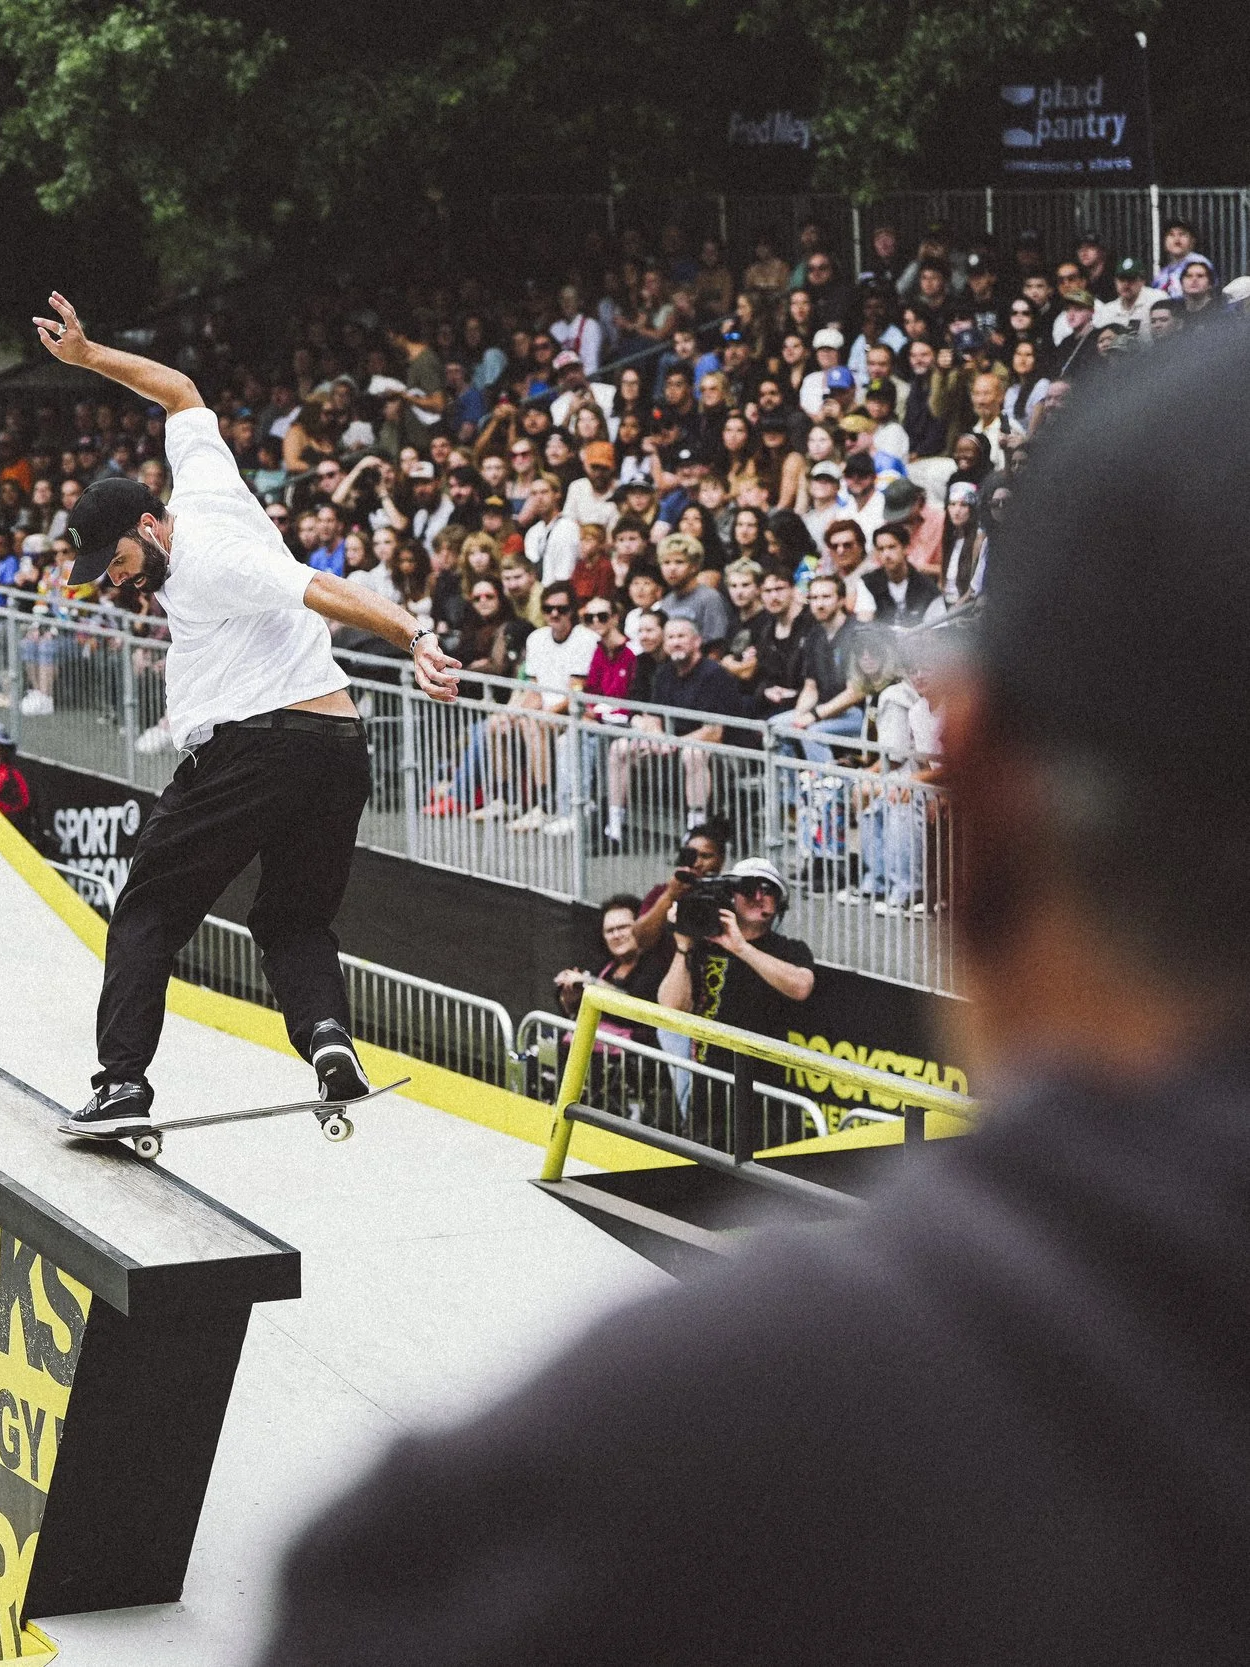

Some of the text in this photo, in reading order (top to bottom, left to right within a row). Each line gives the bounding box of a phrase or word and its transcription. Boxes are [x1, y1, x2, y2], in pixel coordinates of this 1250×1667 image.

[1038, 77, 1103, 114] plad
[1036, 113, 1127, 146] pantry
[54, 806, 124, 856] SPORT
